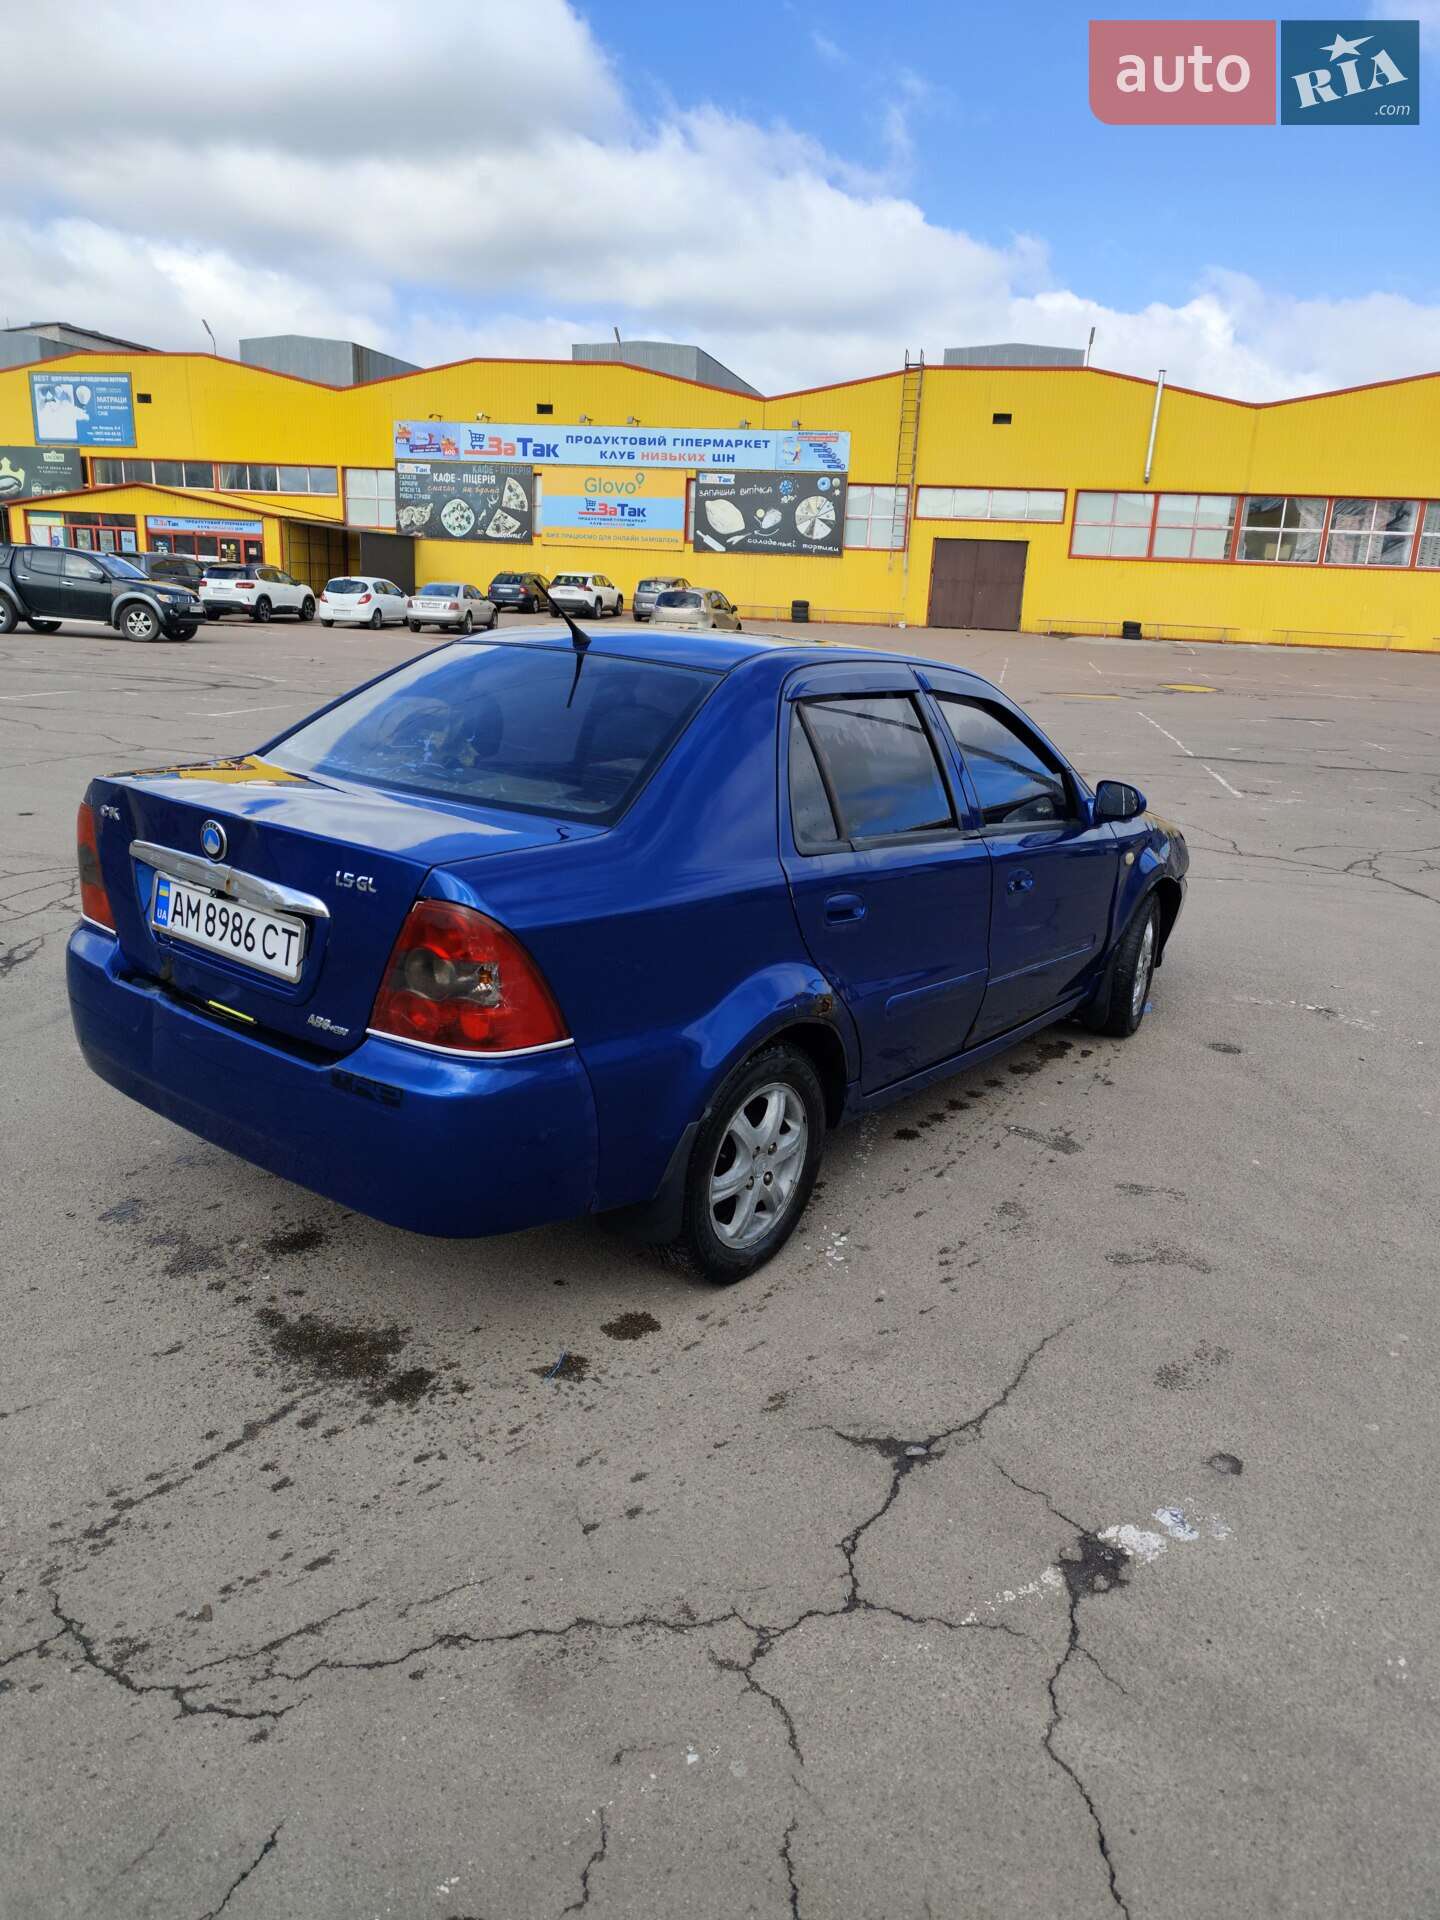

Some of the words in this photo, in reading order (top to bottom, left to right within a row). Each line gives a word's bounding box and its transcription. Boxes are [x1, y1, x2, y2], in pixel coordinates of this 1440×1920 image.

[486, 435, 560, 458] ЗаТак
[565, 434, 667, 447] ПРОДУКТОВИЙ
[672, 437, 771, 449] ГІПЕРМАРКЕТ
[599, 450, 636, 460] КЛУБ
[640, 452, 706, 462] НИЗЬКИХ
[711, 453, 736, 463] ЦІН
[432, 473, 456, 483] КАФЕ
[462, 474, 496, 485] ПІЦЕРІЯ
[583, 476, 637, 495] Glovo
[597, 502, 647, 518] ЗаТак
[356, 875, 377, 893] GL
[156, 907, 168, 919] UA
[170, 891, 201, 933] AM
[204, 902, 256, 952] 8986
[262, 923, 299, 966] CT
